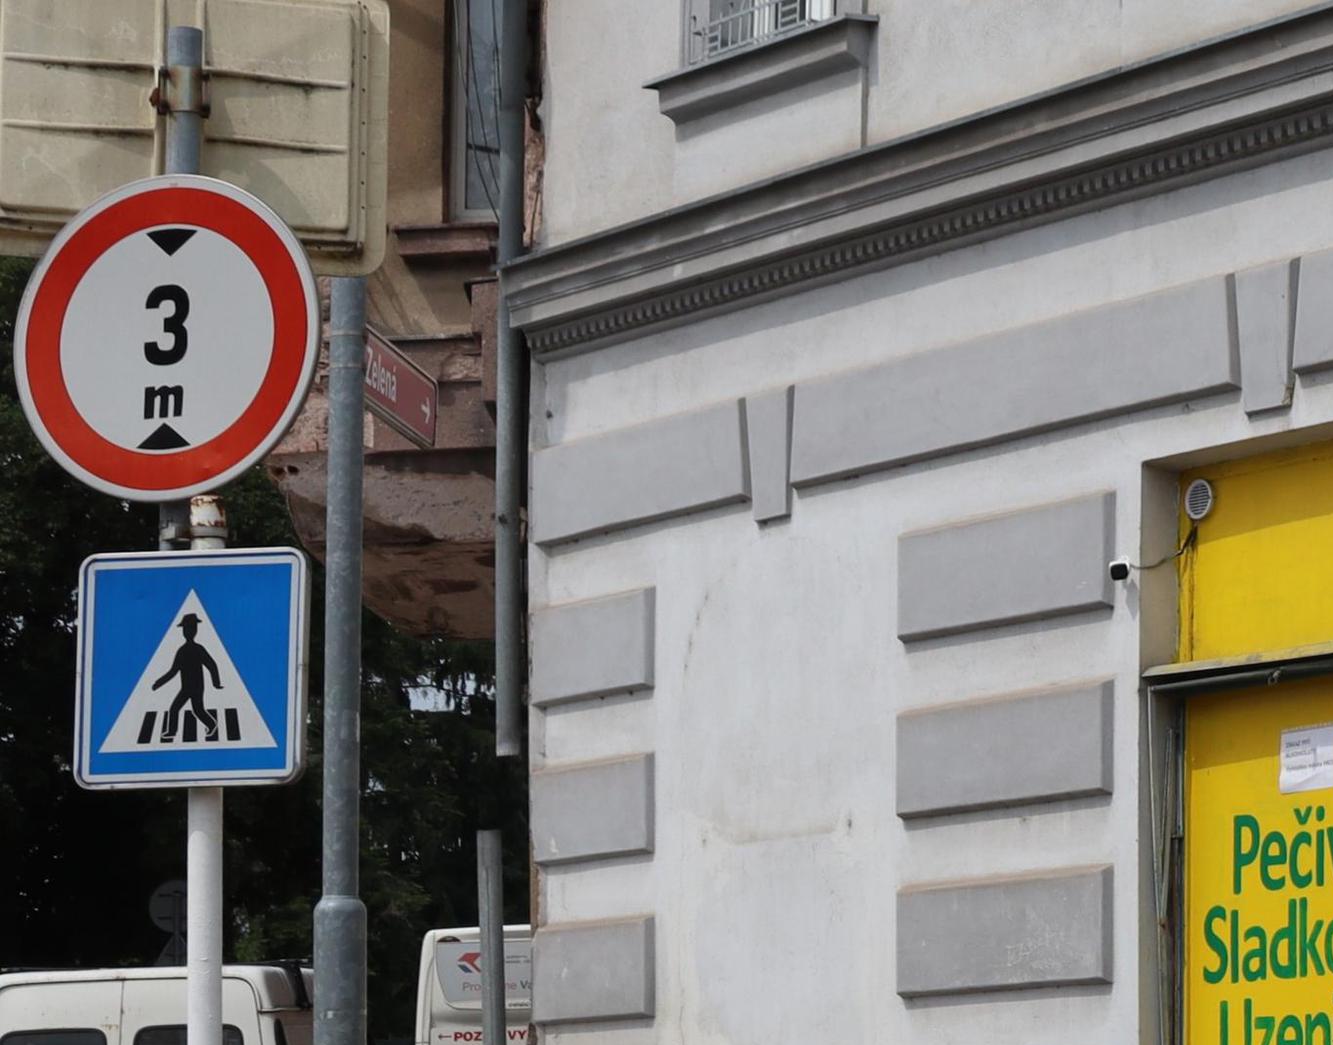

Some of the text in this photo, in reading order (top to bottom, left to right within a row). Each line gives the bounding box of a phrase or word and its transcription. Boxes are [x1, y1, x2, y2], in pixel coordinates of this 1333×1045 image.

[143, 284, 190, 367] 3
[365, 345, 397, 403] Zelená
[143, 381, 184, 419] m
[453, 1029, 528, 1042] POZ VY
